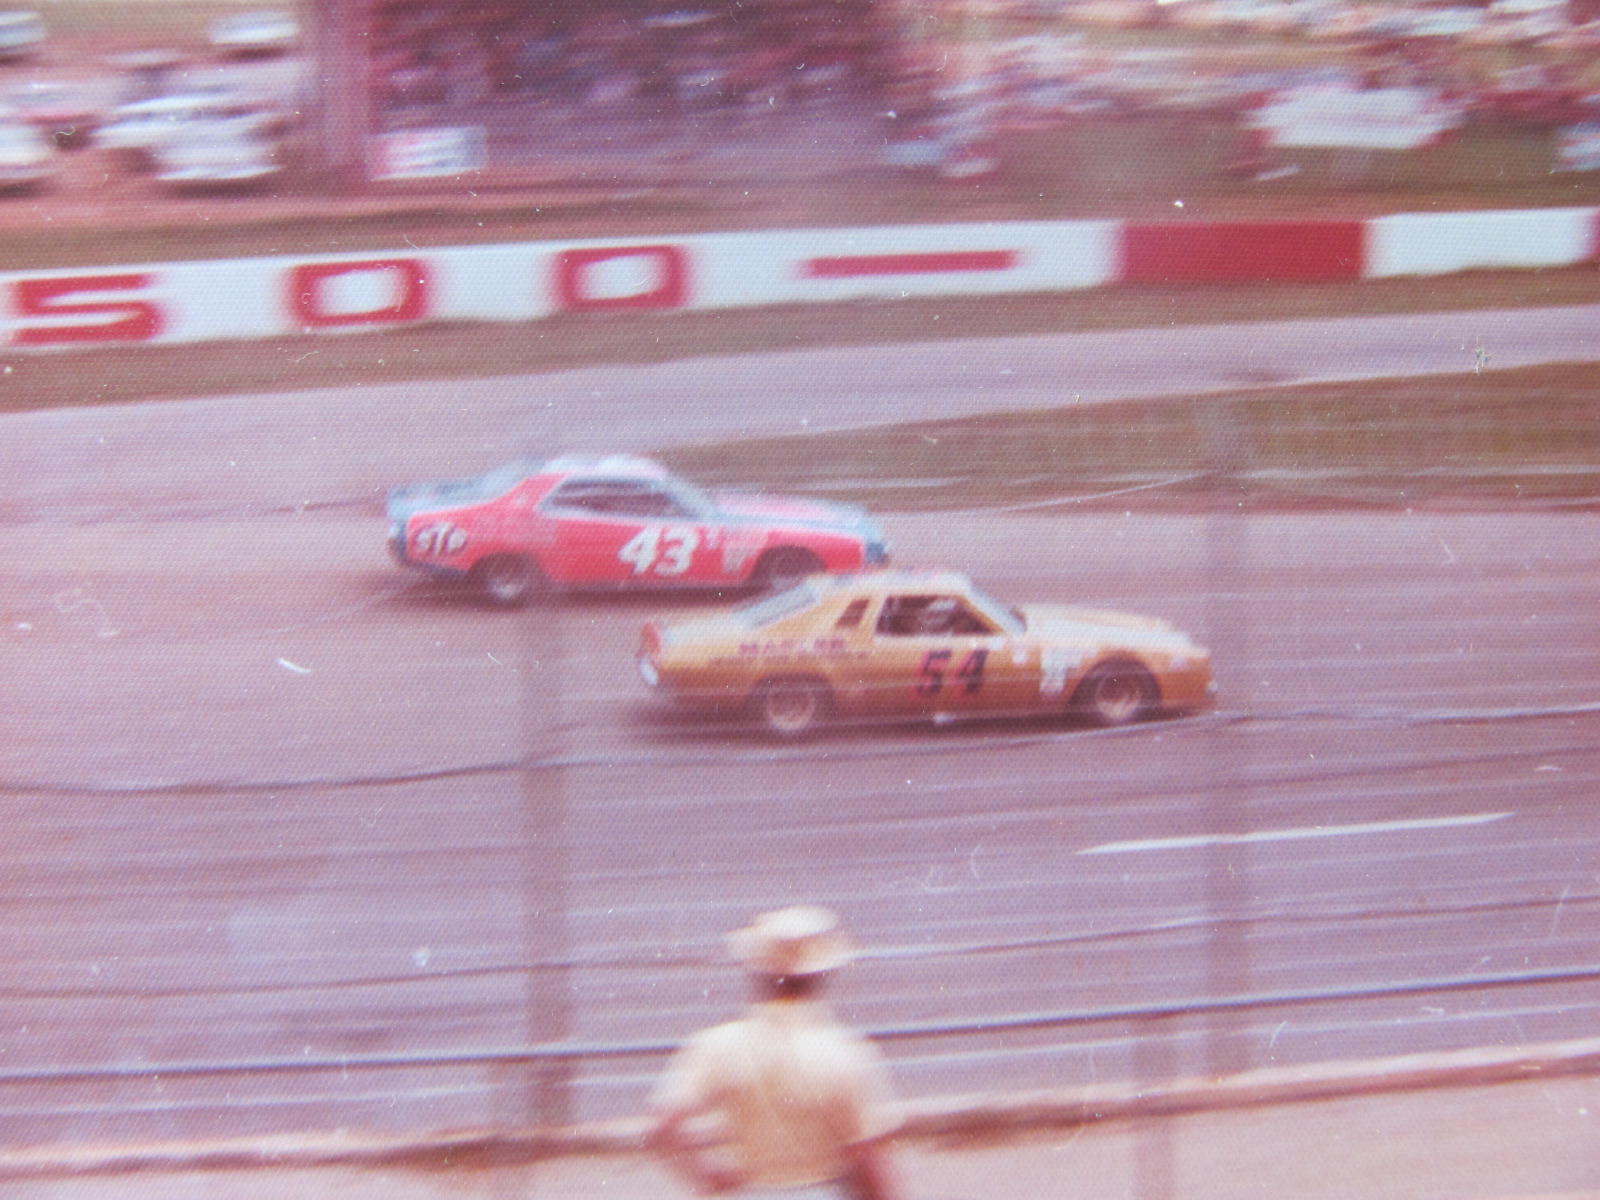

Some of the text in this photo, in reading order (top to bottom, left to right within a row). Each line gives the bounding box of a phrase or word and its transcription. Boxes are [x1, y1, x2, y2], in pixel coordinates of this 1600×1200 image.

[6, 244, 692, 345] 500
[416, 521, 468, 555] STP
[618, 526, 699, 576] 43
[913, 648, 989, 698] 54
